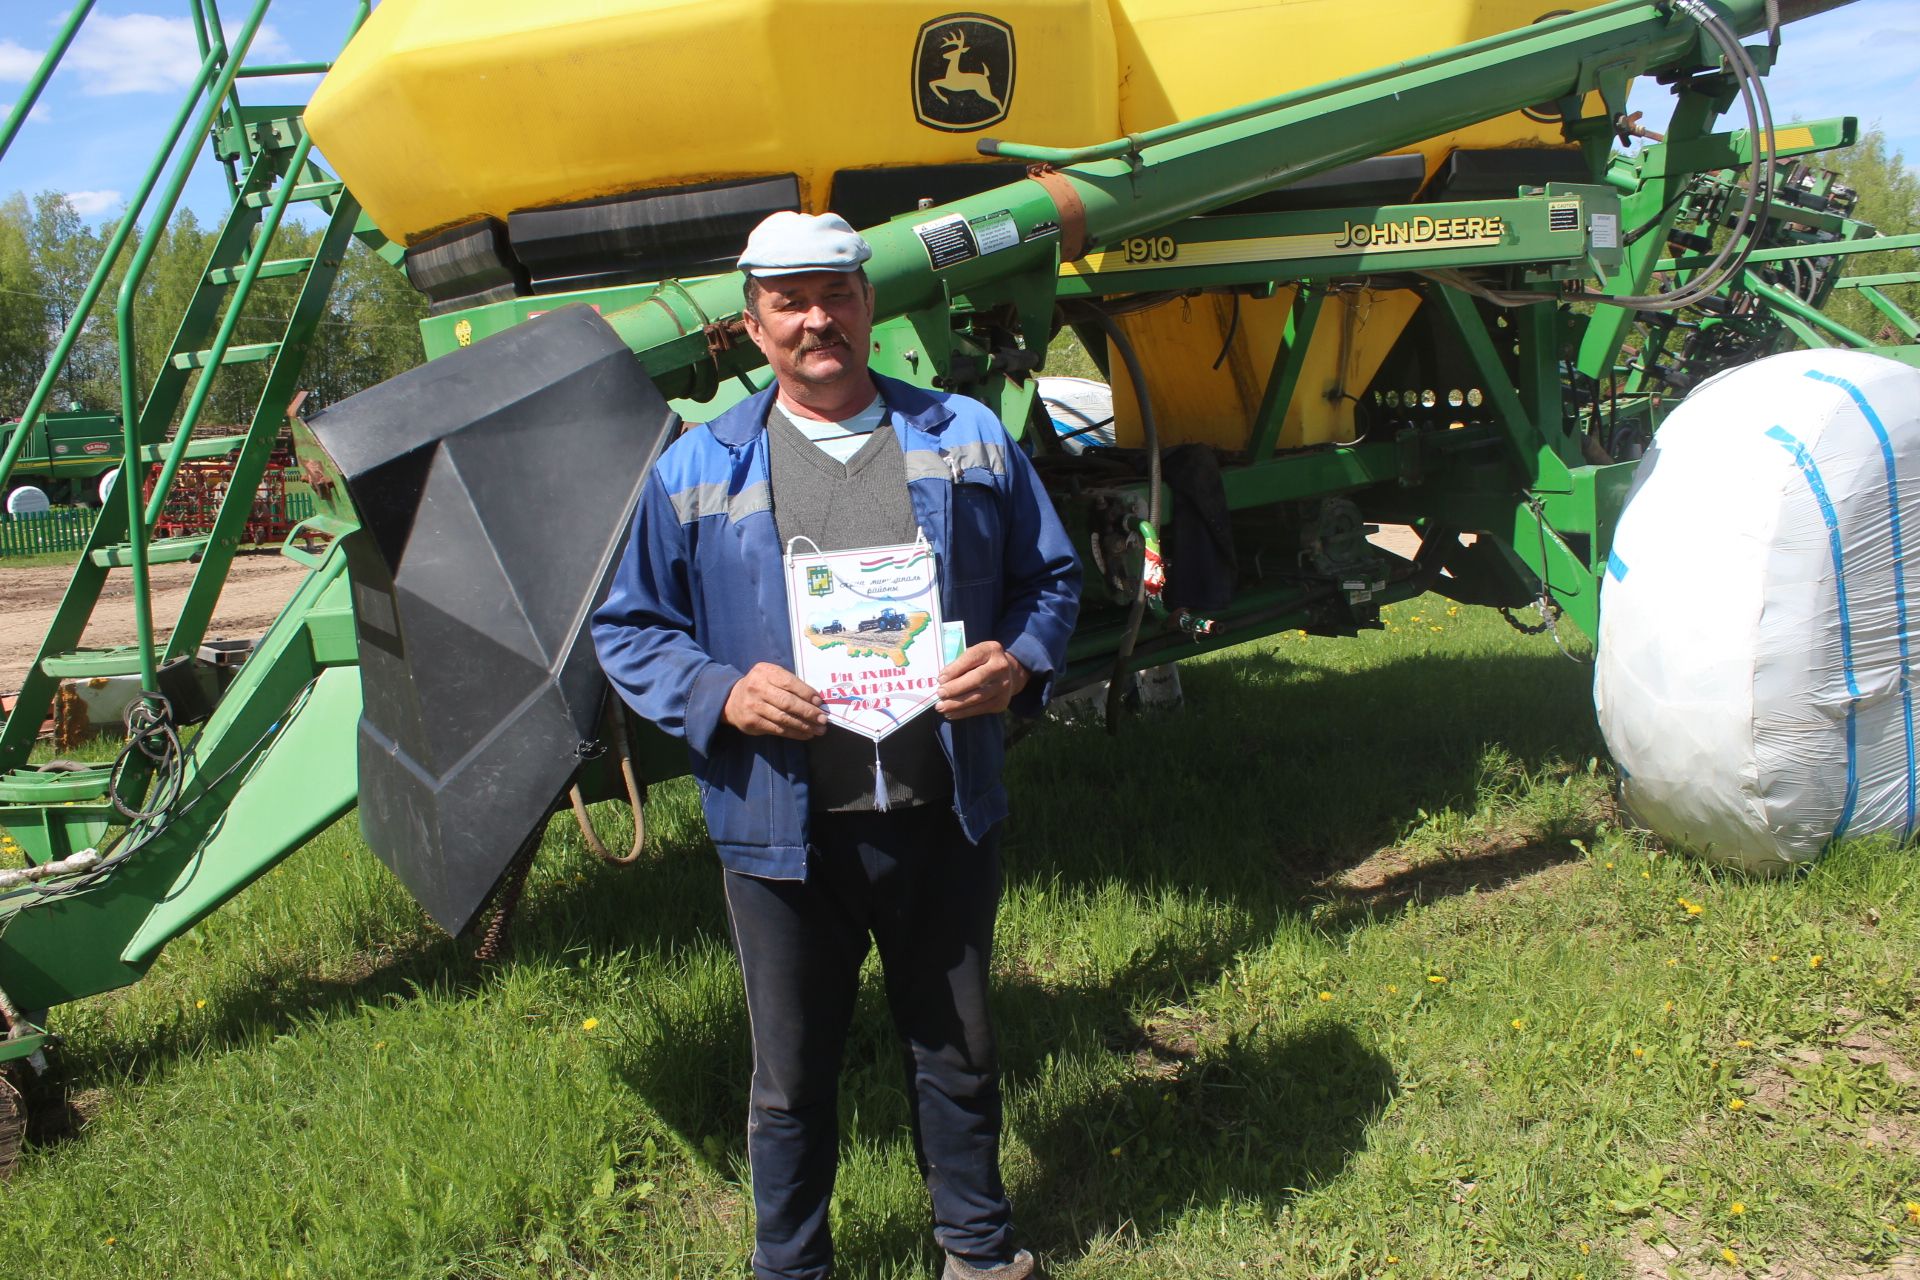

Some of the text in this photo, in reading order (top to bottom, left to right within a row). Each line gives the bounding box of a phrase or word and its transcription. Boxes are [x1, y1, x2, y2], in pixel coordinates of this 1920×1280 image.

[1335, 216, 1502, 248] JOHN DEERE
[1121, 236, 1176, 262] 1910
[852, 696, 892, 711] 2023
